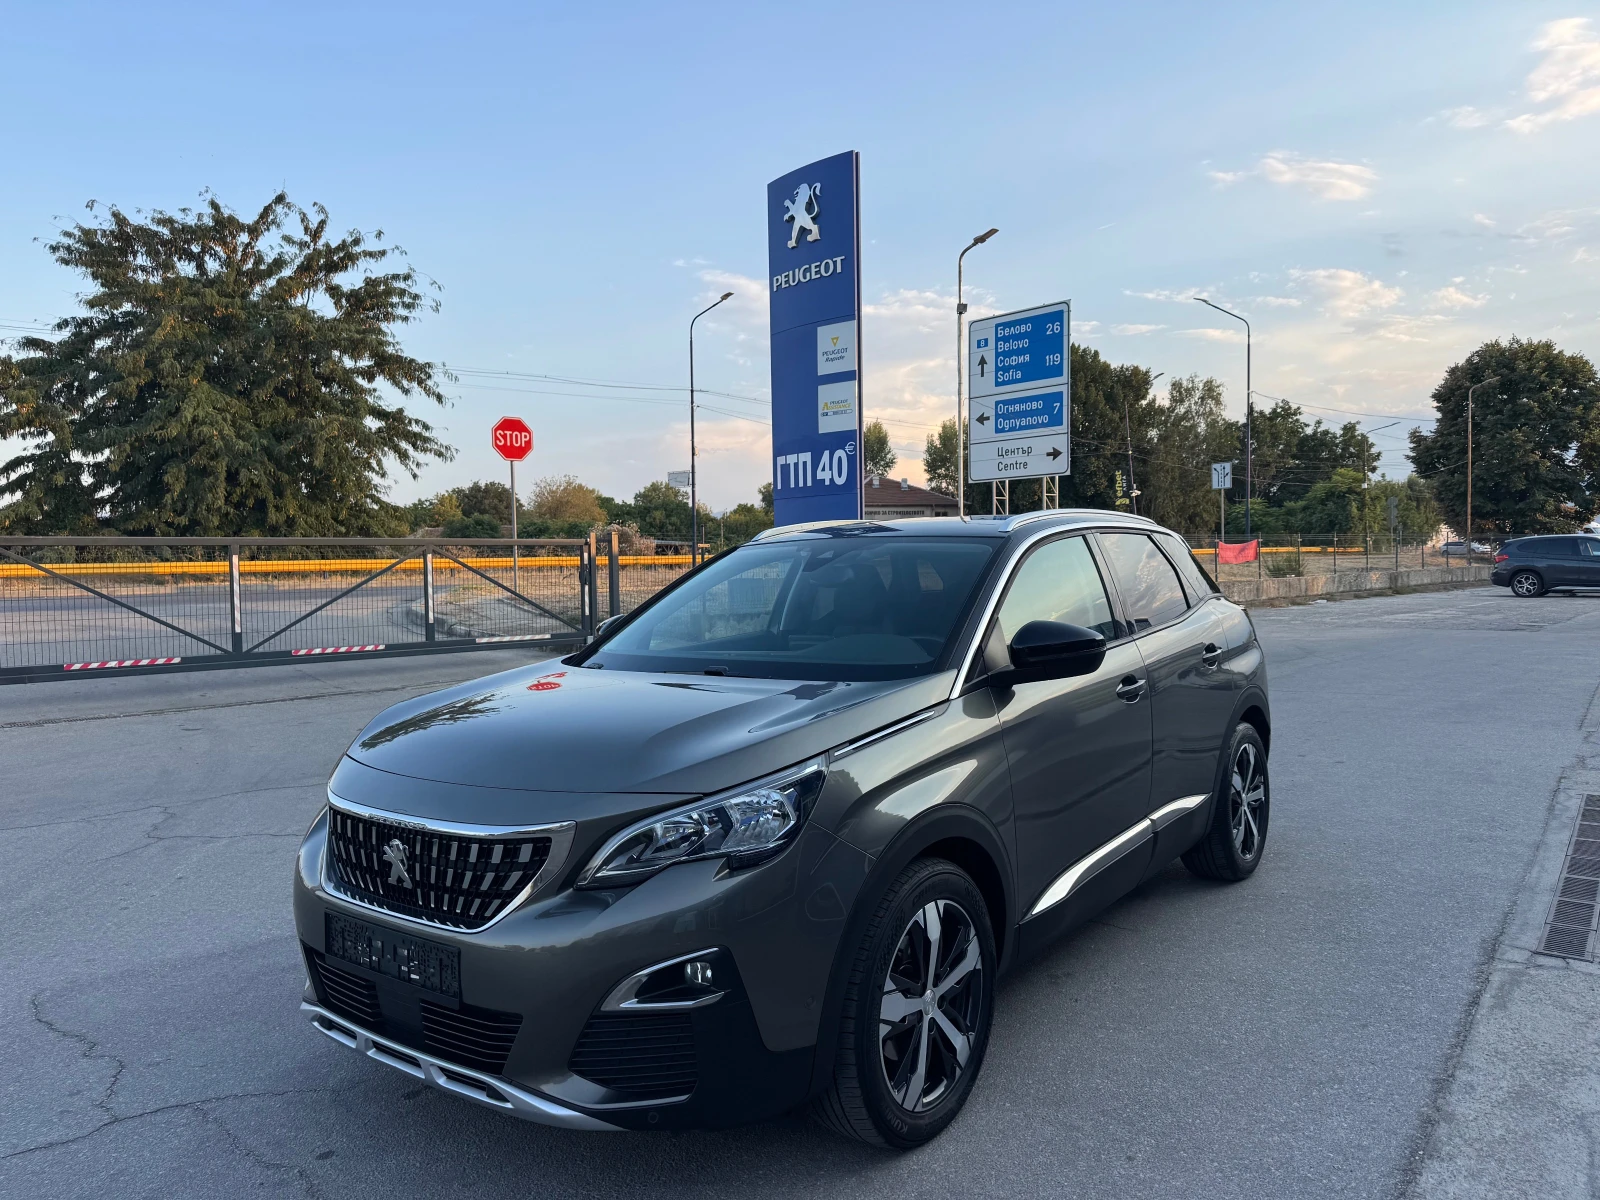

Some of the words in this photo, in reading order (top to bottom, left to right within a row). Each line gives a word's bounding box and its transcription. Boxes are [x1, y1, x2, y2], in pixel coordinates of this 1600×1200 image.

[773, 256, 845, 292] PEUGEOT
[997, 323, 1032, 337] Белово
[1046, 322, 1061, 335] 26
[822, 347, 848, 357] PEUGEOT
[997, 338, 1029, 352] Belovo
[997, 354, 1030, 367] София
[1045, 353, 1061, 366] 119
[997, 369, 1022, 382] Sofia
[997, 400, 1043, 415] Огняново
[1053, 403, 1060, 414] 7
[997, 414, 1049, 430] Ognyanovo
[496, 430, 530, 447] STOP
[997, 445, 1033, 459] Център
[776, 452, 812, 490] ГТП
[997, 460, 1028, 472] Centre
